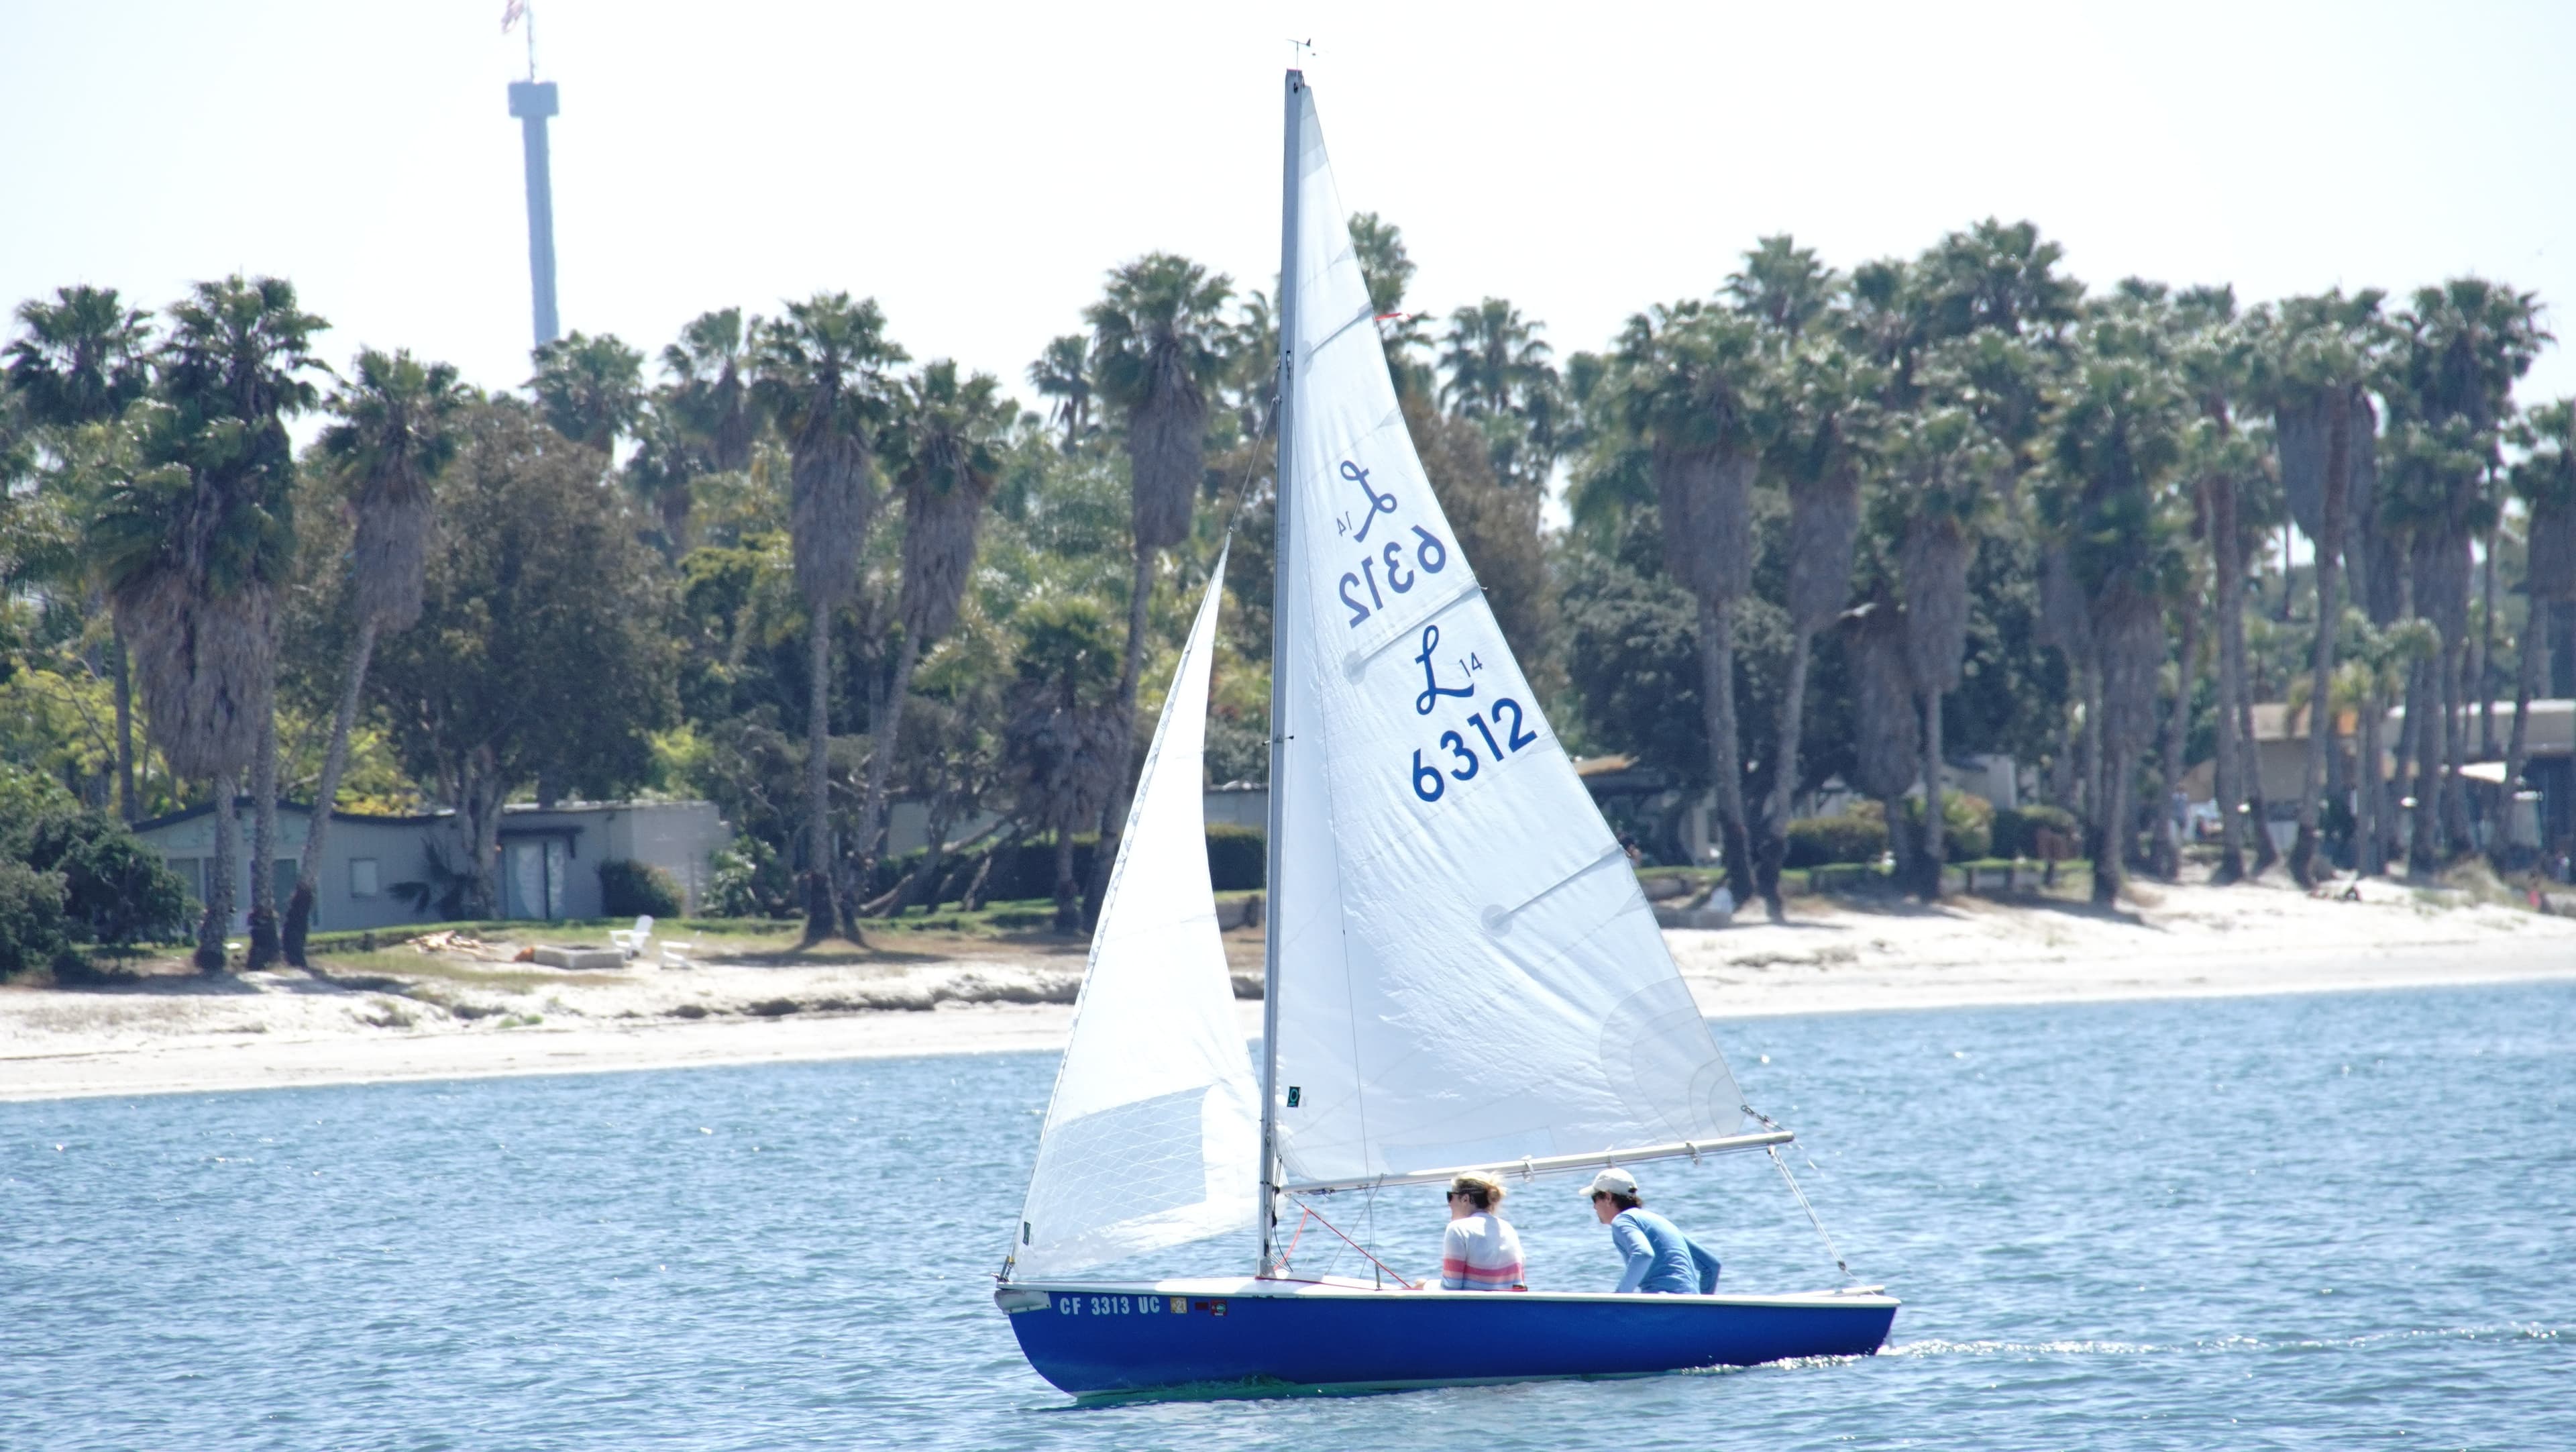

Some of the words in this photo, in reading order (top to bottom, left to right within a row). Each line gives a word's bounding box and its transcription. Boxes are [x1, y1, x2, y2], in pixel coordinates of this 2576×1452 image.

[1459, 652, 1483, 678] 14
[1412, 697, 1538, 802] 6312
[1060, 1297, 1081, 1315] CF
[1091, 1296, 1130, 1315] 3313
[1138, 1296, 1160, 1314] UC
